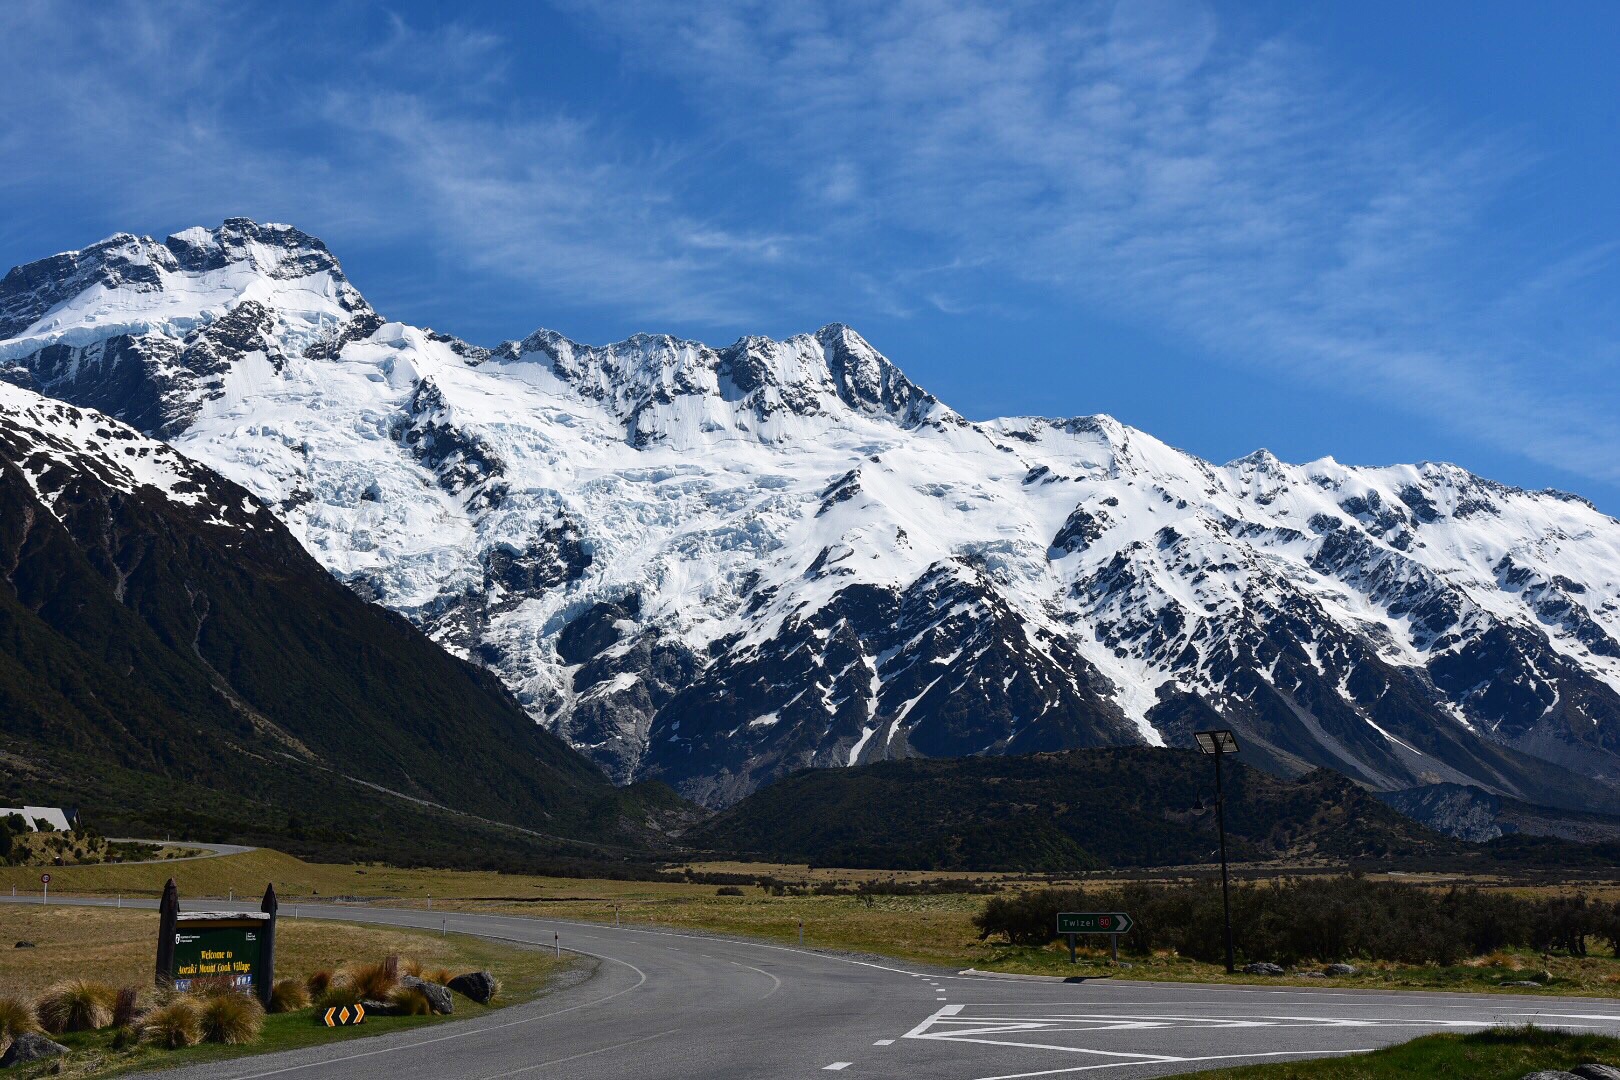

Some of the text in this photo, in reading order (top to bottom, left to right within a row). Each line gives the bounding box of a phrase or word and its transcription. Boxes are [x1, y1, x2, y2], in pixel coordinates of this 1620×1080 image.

[201, 950, 232, 959] Welcome to
[178, 961, 250, 974] Aoraki Mount Cook Village
